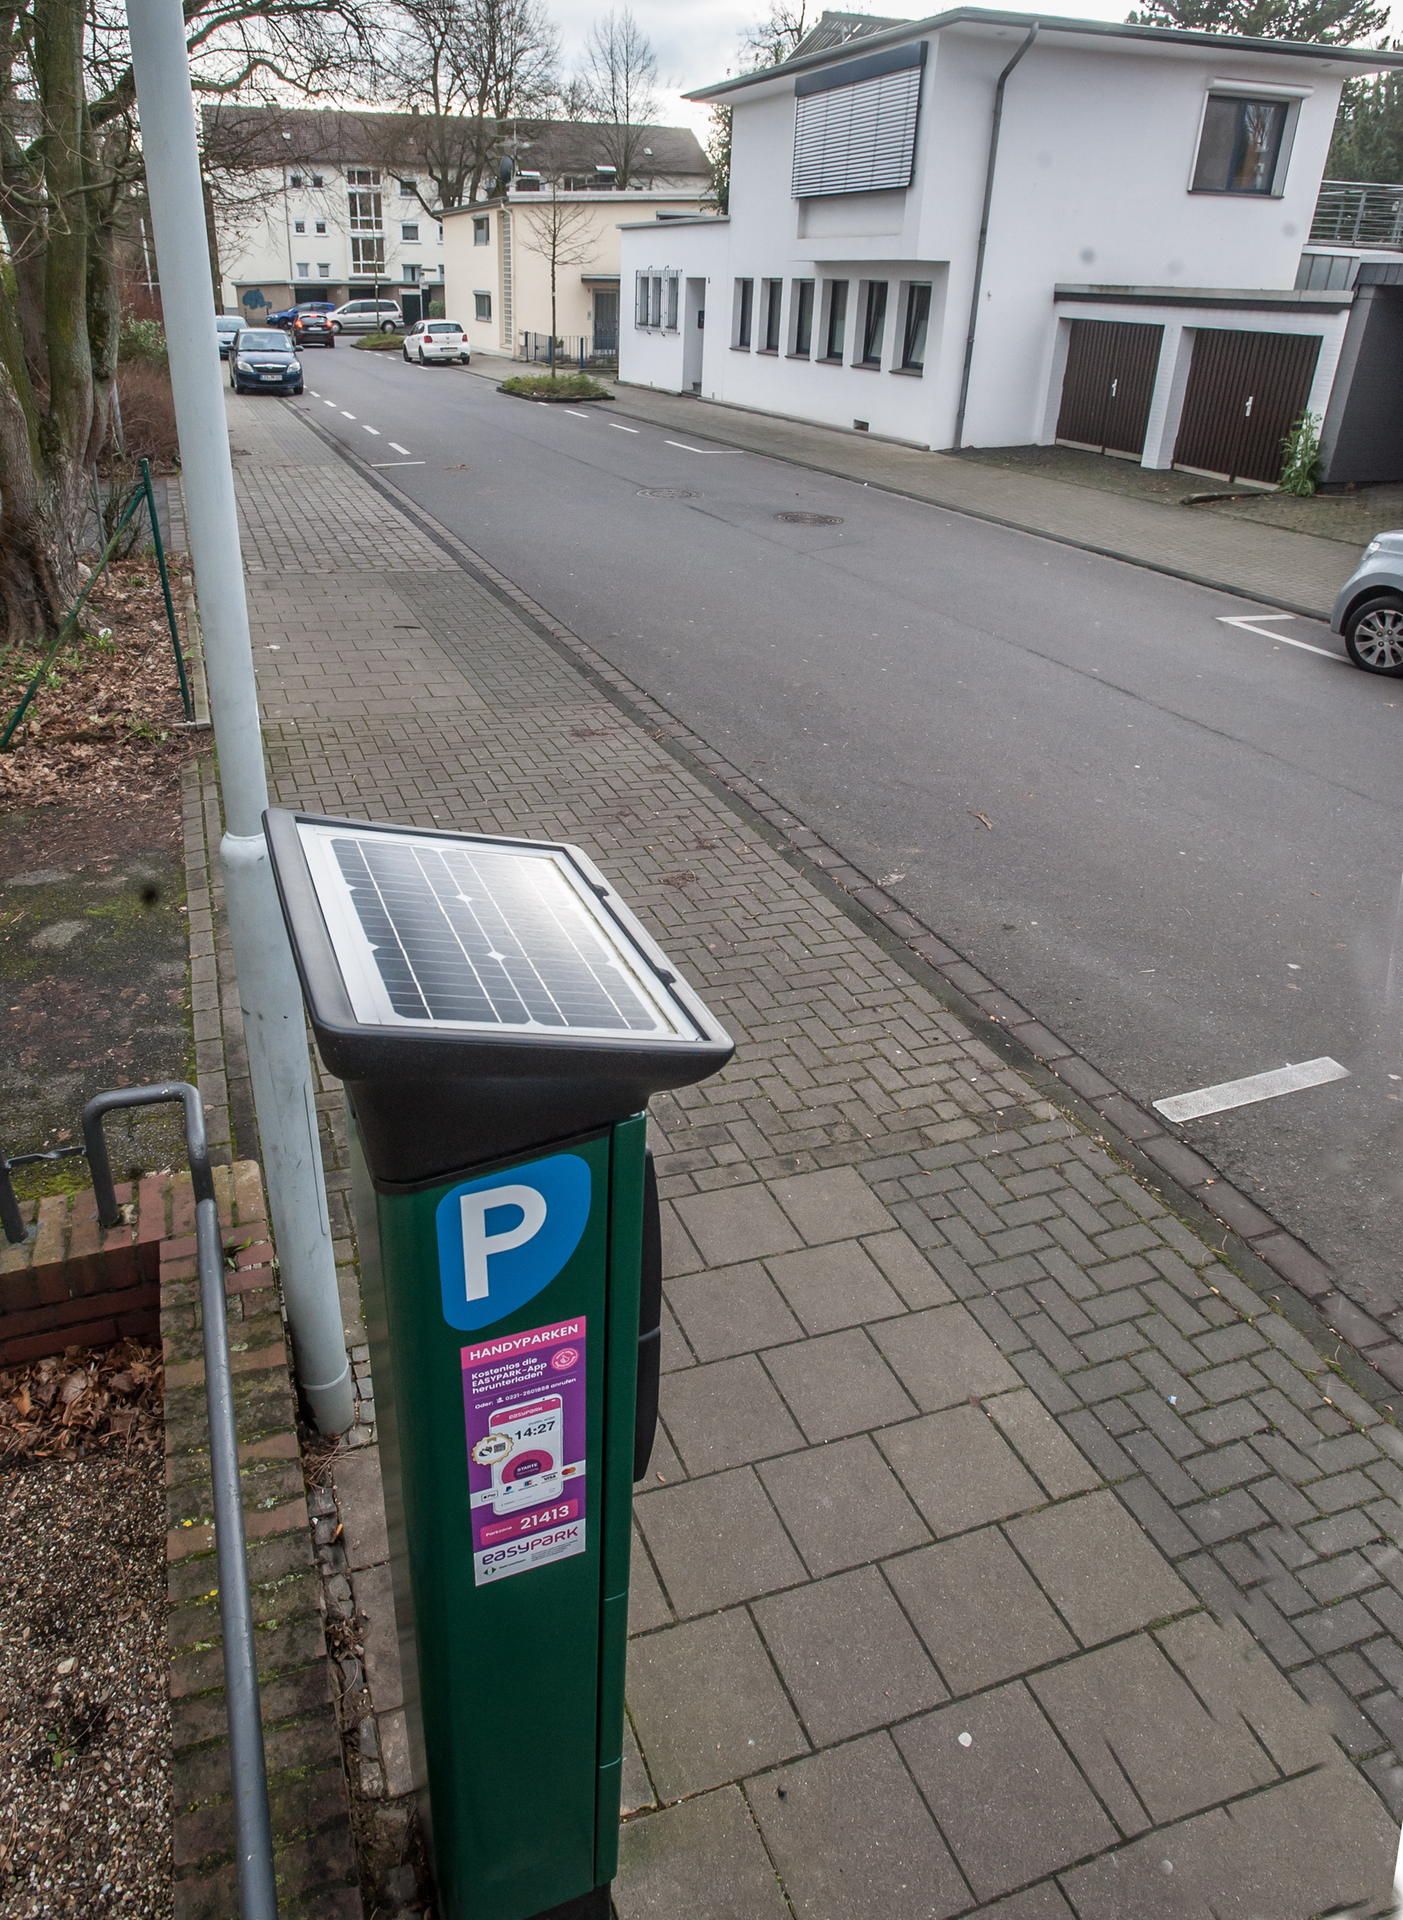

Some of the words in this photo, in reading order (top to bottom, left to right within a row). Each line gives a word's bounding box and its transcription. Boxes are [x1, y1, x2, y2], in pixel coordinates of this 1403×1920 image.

[459, 1184, 547, 1302] P
[469, 1323, 578, 1361] HANDYPARKEN
[471, 1362, 520, 1380] Kostenlos
[522, 1357, 538, 1366] die
[471, 1362, 548, 1388] EASYPARK-App
[472, 1370, 543, 1395] herunterladen
[550, 1378, 577, 1389] anrufen
[515, 1421, 555, 1440] 14:27
[520, 1505, 570, 1530] 21413
